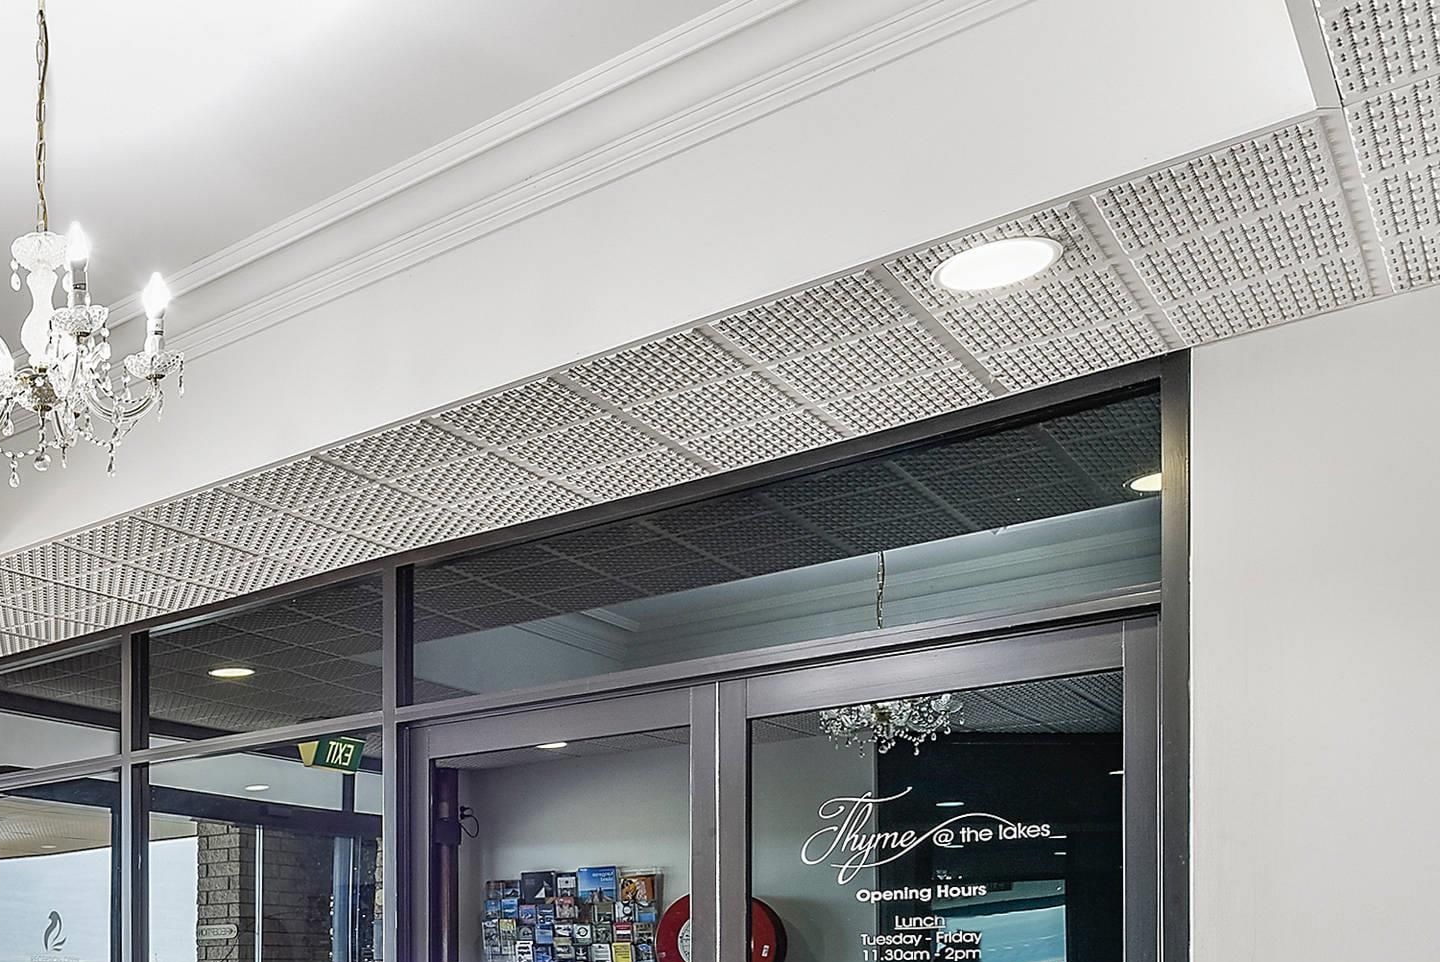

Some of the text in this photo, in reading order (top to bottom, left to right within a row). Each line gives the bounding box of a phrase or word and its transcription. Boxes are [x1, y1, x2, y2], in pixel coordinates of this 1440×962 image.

[801, 787, 1050, 884] Thyme @ the lakes
[856, 884, 987, 904] Opening Hours
[895, 915, 946, 929] Lunch
[861, 933, 922, 946] Tuesday
[936, 931, 982, 945] Friday
[863, 948, 930, 961] 11.30am
[945, 948, 982, 962] 2pm
